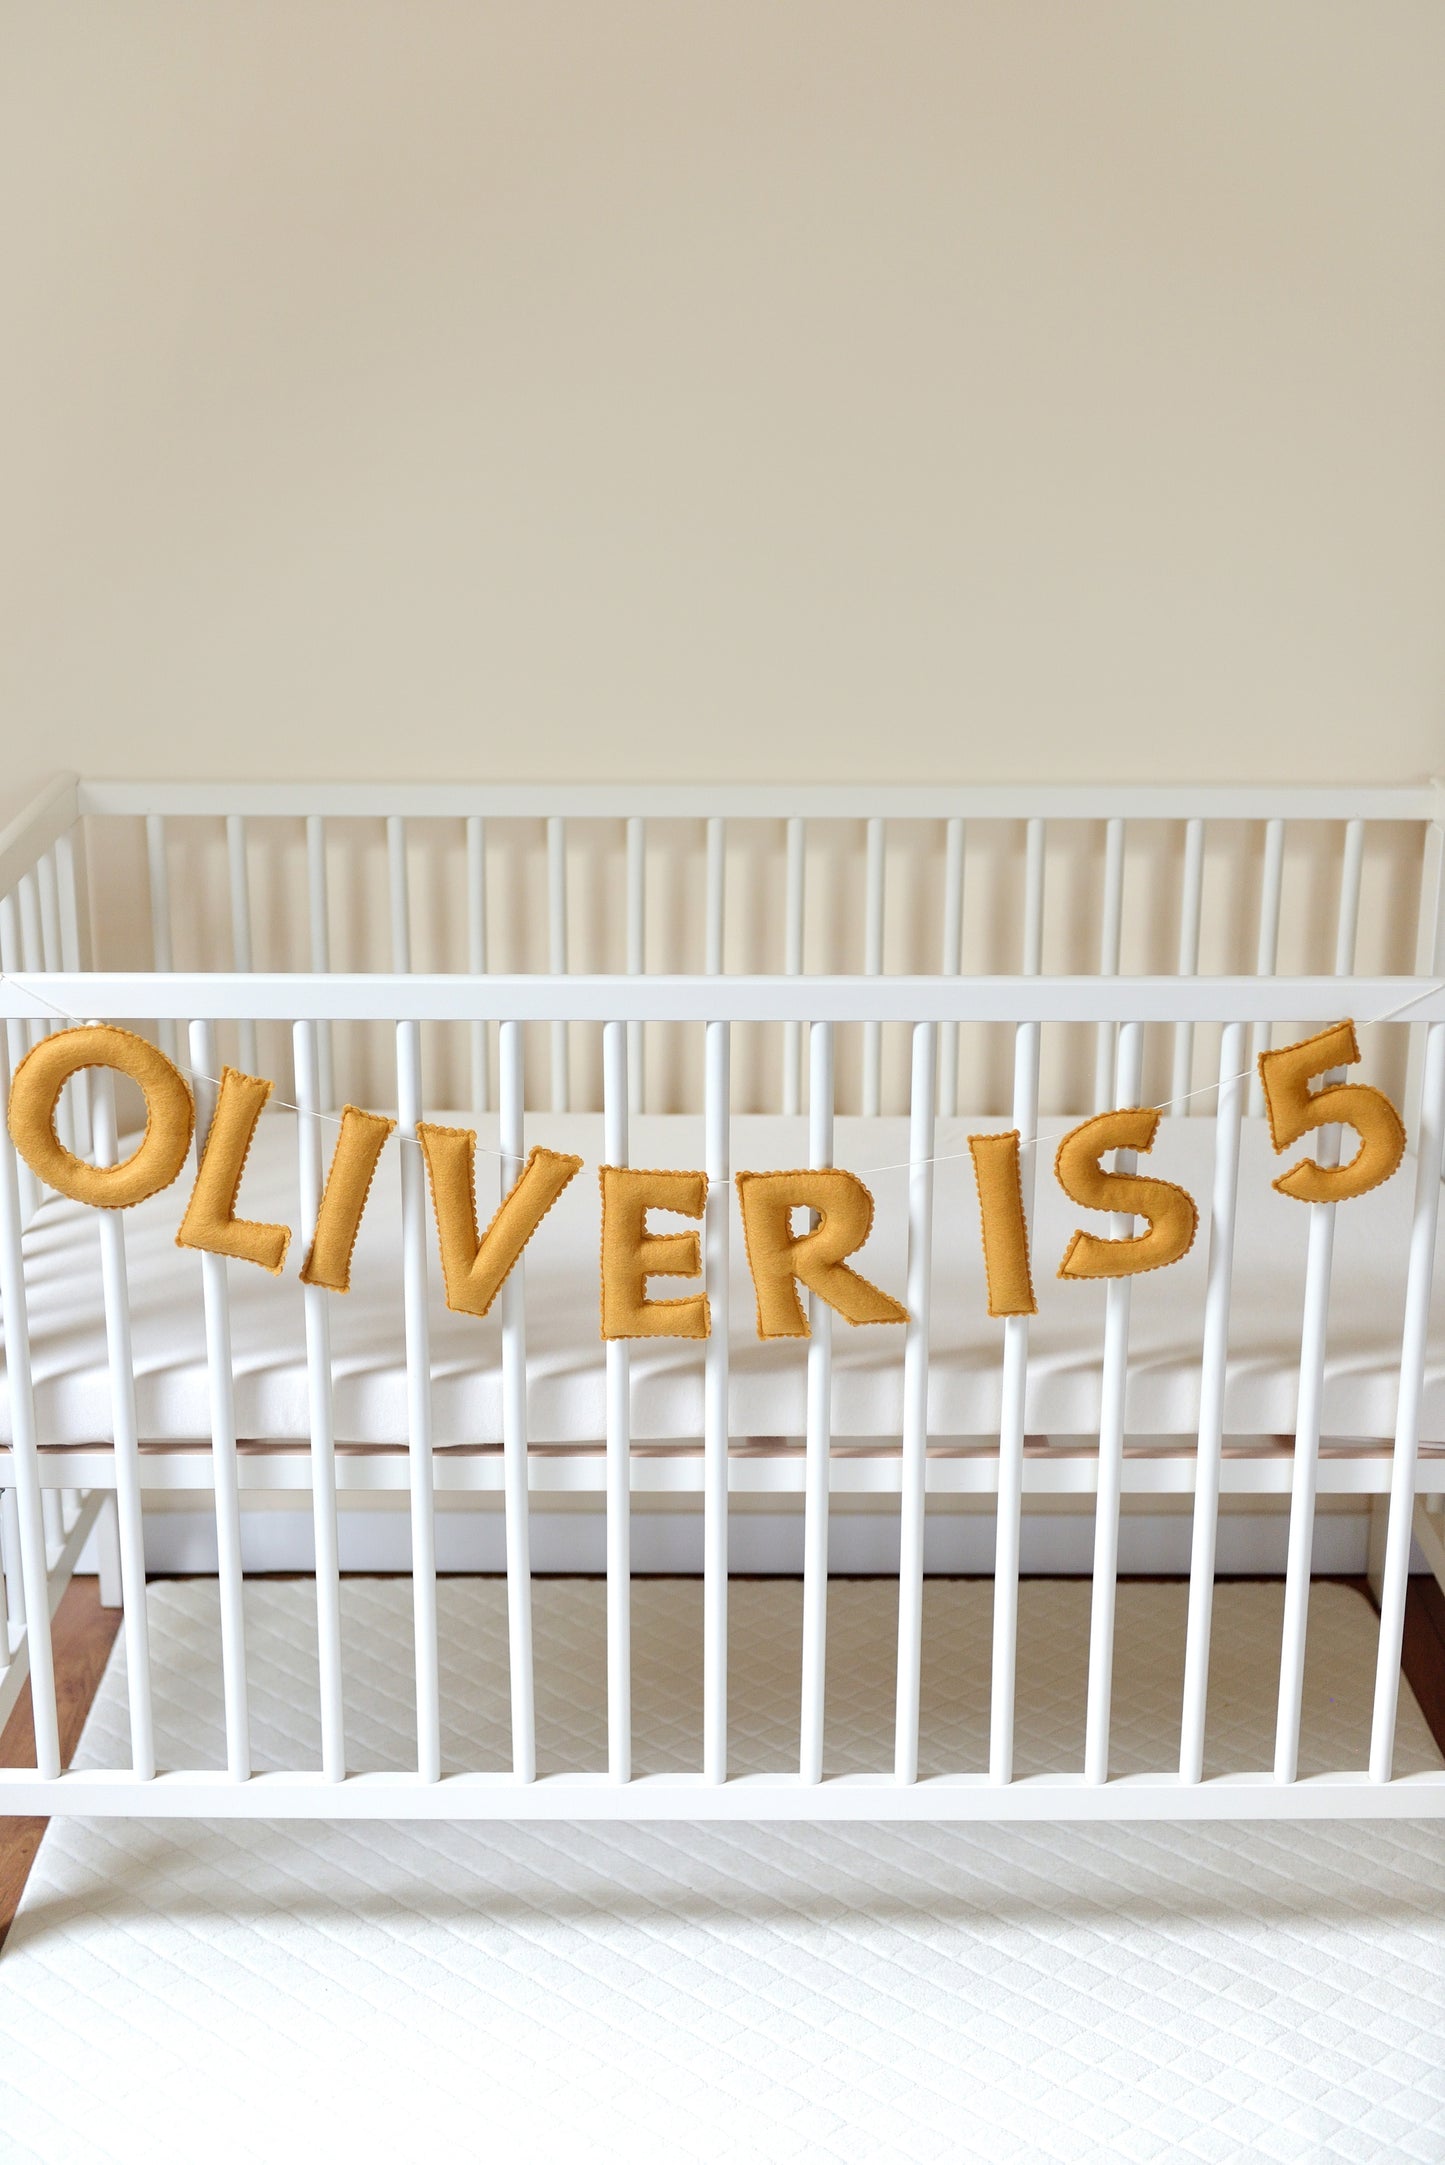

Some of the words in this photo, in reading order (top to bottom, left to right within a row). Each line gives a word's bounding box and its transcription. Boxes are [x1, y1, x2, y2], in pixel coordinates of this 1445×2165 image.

[8, 1023, 909, 1340] OLIVER
[968, 1107, 1199, 1316] IS
[1259, 1019, 1407, 1202] 5
